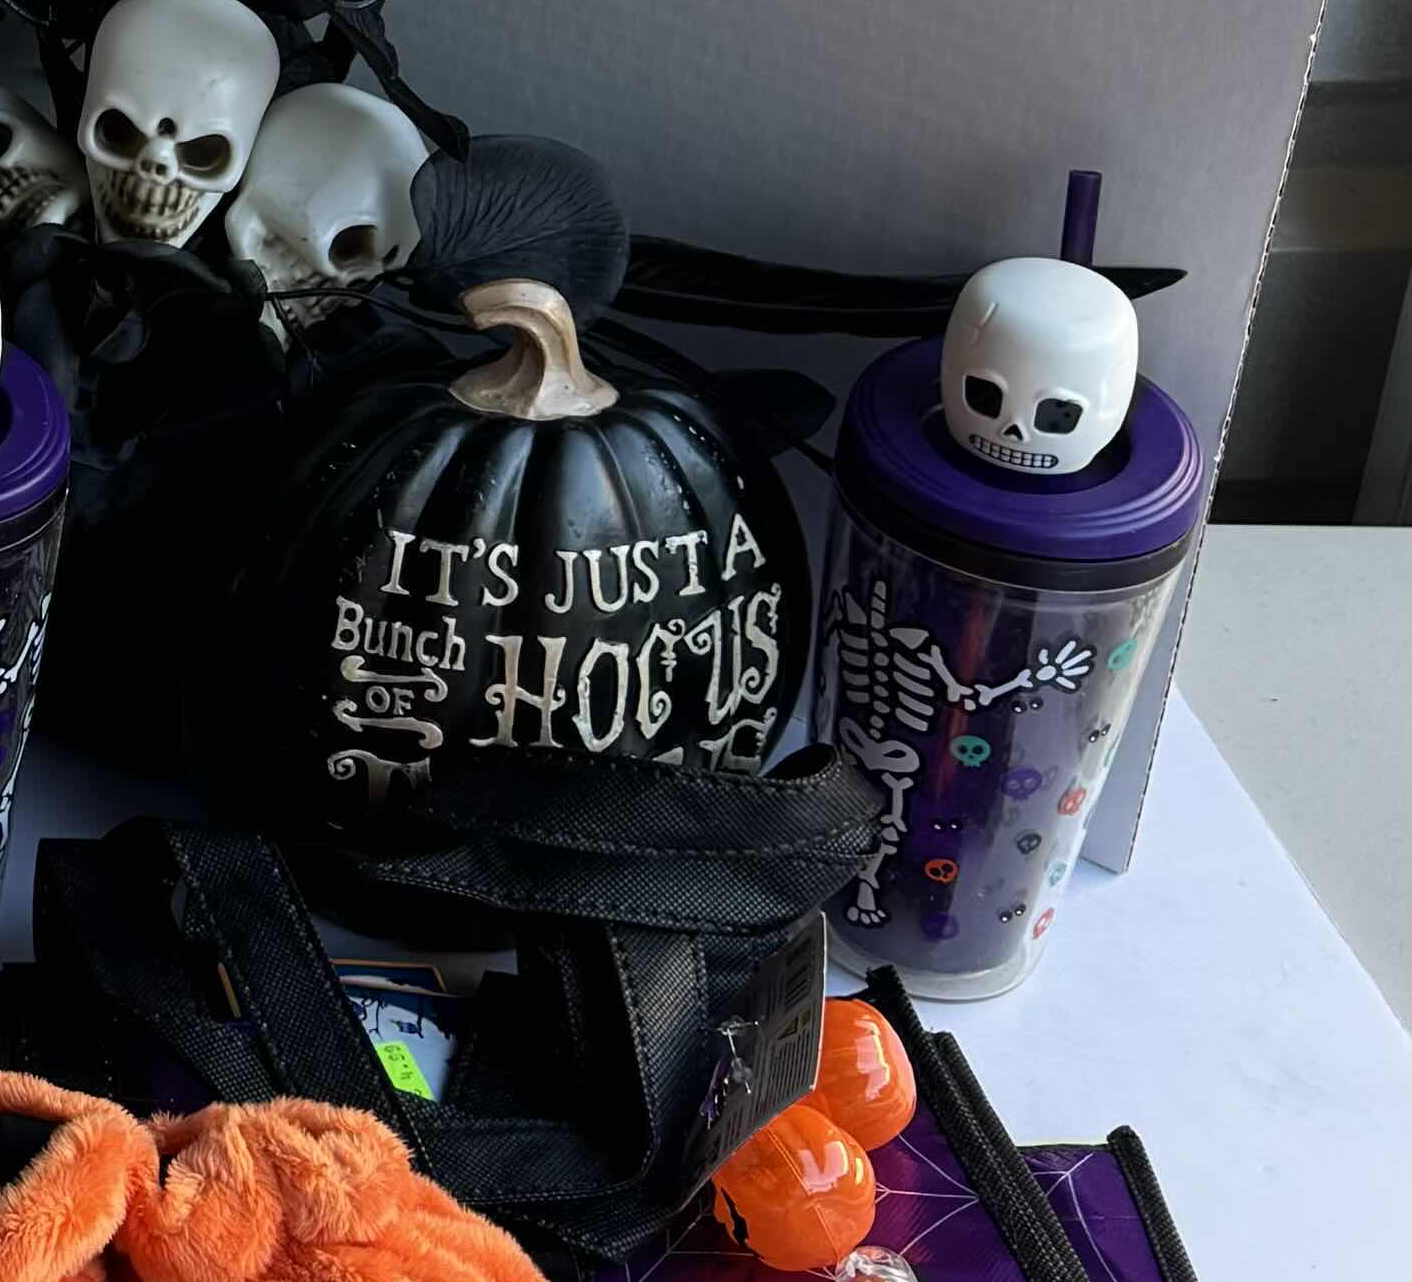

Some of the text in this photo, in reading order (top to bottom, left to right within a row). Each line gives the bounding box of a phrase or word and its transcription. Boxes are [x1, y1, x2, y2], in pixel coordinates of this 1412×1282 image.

[545, 513, 766, 615] JUST A
[331, 595, 466, 672] Bunch
[469, 583, 782, 753] HOCUS
[365, 685, 415, 715] OF
